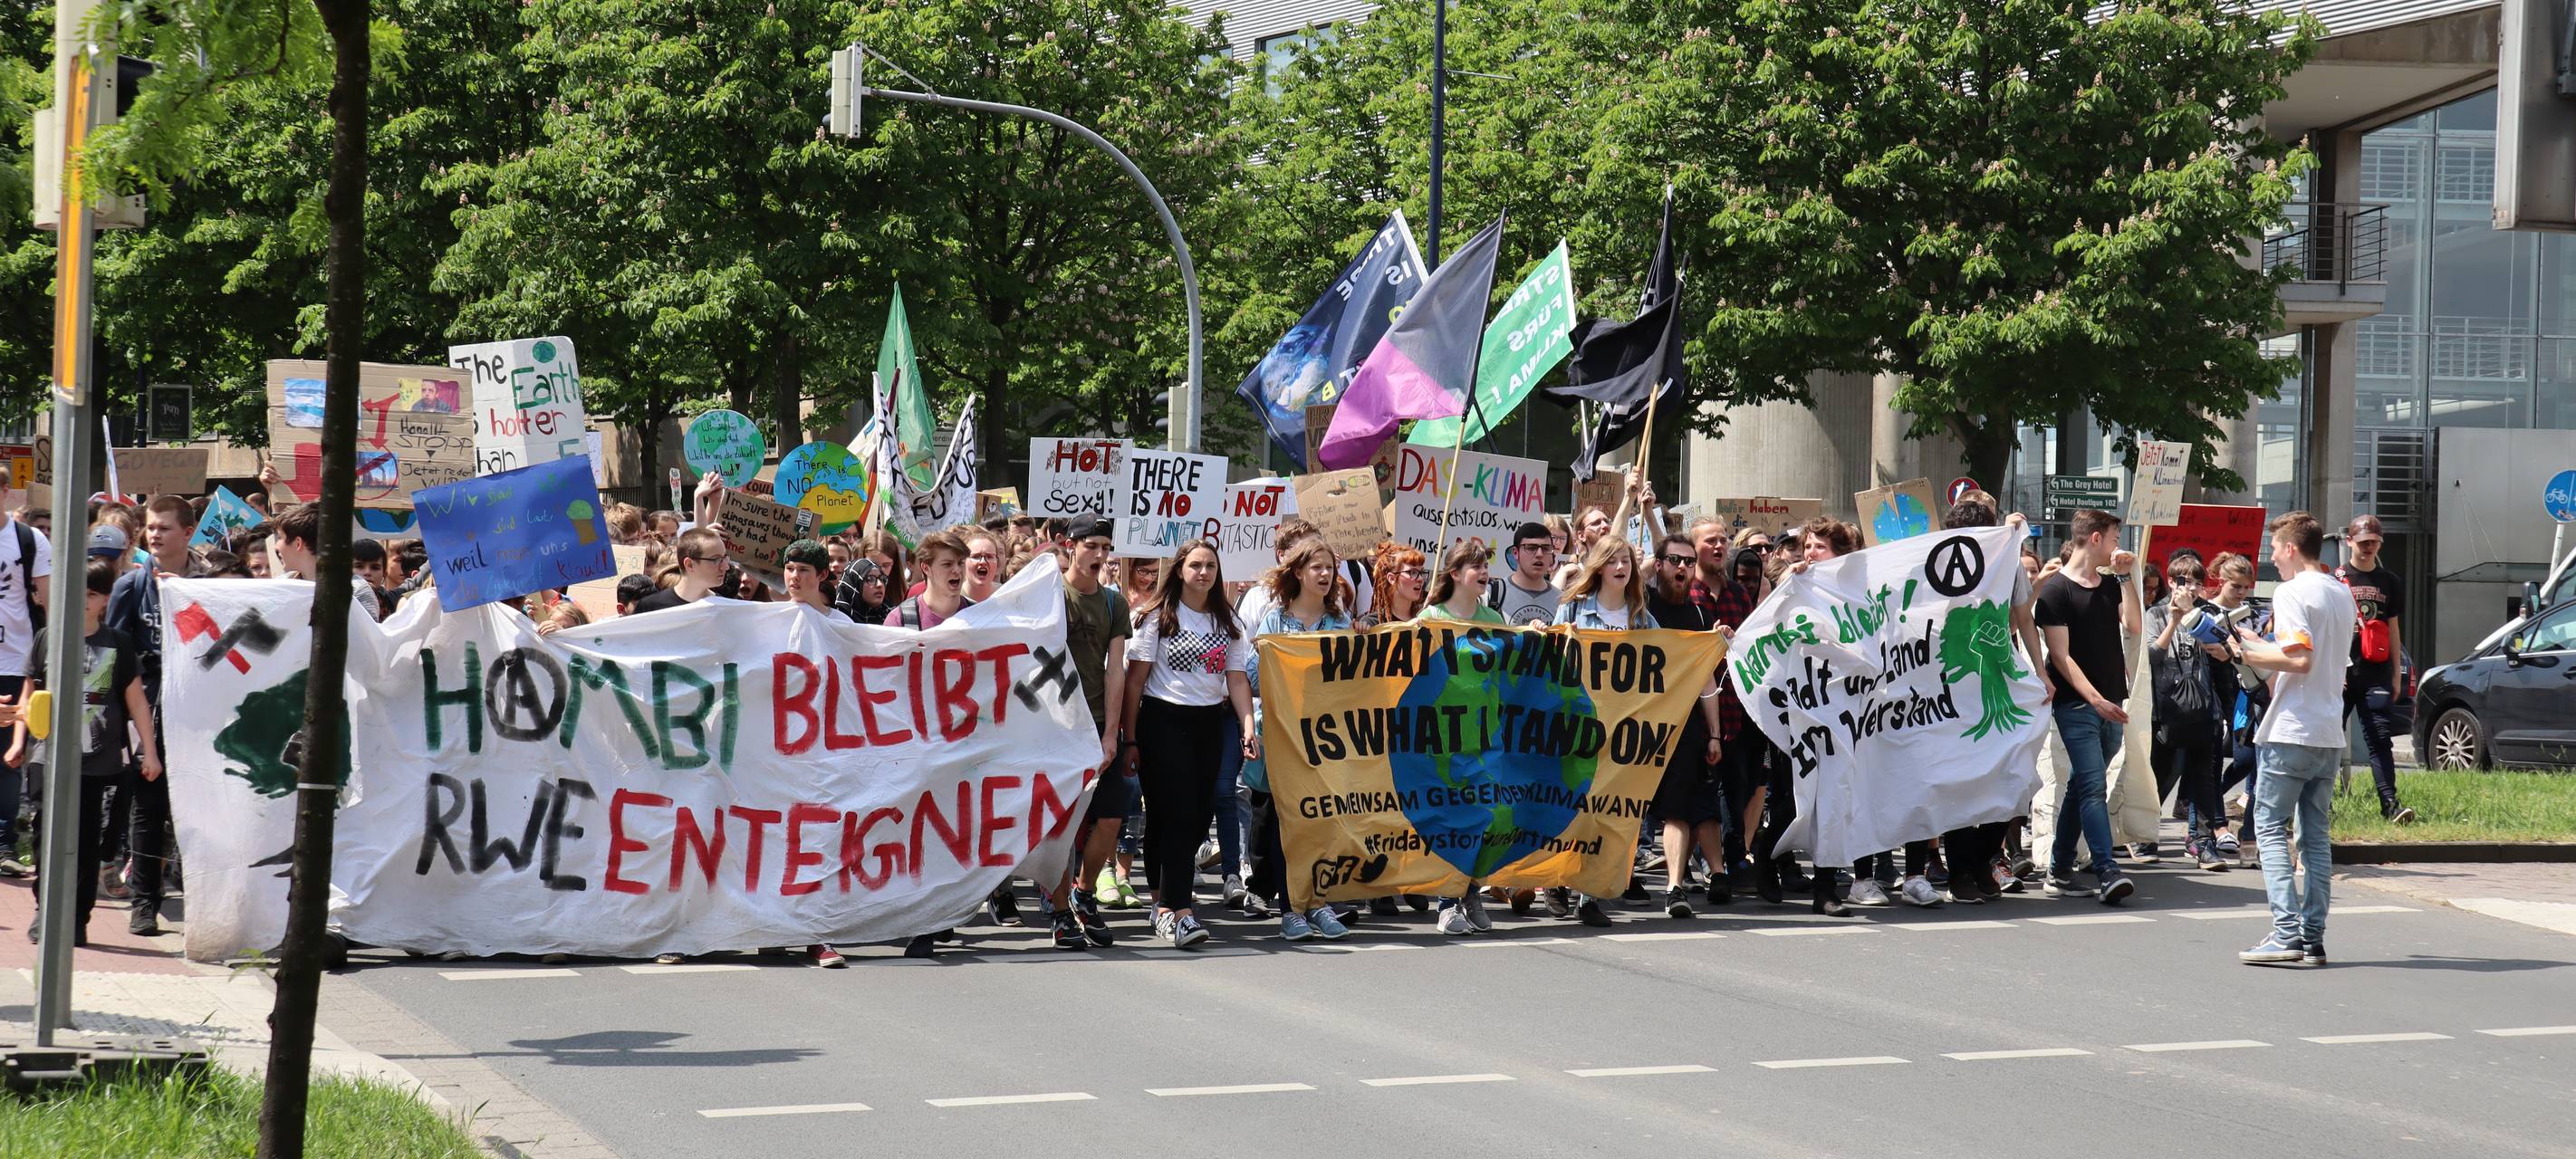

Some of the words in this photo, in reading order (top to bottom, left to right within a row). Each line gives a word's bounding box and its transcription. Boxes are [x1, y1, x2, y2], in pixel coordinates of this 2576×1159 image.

[454, 352, 507, 385] The
[509, 363, 582, 410] Earth
[490, 407, 568, 437] hotter
[395, 435, 475, 455] STOPP
[2140, 441, 2163, 466] Jetzt
[476, 446, 518, 476] han
[795, 459, 829, 471] There
[1132, 457, 1204, 493] THERE
[787, 477, 812, 494] NO
[1051, 473, 1081, 489] but
[1085, 474, 1113, 488] not
[2060, 479, 2073, 489] The
[2075, 480, 2092, 491] Grey
[2092, 480, 2112, 490] Hotel
[725, 492, 742, 509] I'm
[743, 502, 769, 517] sure
[774, 508, 792, 522] the
[816, 494, 854, 507] Planet
[1130, 490, 1151, 517] IS
[1157, 490, 1192, 518] NO
[1235, 485, 1286, 518] NOT
[1749, 499, 1789, 514] haben
[2059, 497, 2076, 505] Hotel
[2076, 498, 2103, 508] Boutique
[2104, 499, 2117, 507] 102
[722, 511, 771, 532] dinosaurs
[1128, 518, 1202, 548] PLANET
[1504, 519, 1523, 532] wi
[1732, 513, 1748, 527] die
[725, 539, 745, 554] ime
[745, 528, 768, 543] had
[447, 541, 490, 576] weil
[1320, 627, 1431, 683] WHAT
[1442, 628, 1458, 675] I
[1466, 627, 1583, 689] STAND
[1590, 641, 1667, 694] FOR
[419, 640, 739, 771] HAMBI
[771, 642, 1030, 756] BLEIBT
[1839, 674, 1960, 752] Verstand
[1300, 716, 1347, 767] IS
[1345, 704, 1468, 757] WHAT
[1480, 705, 1492, 752] I
[1497, 704, 1607, 760] TAND
[1610, 715, 1677, 768] ON!
[1300, 790, 1420, 820] GEMEINSAM
[1426, 781, 1500, 808] GEGEN
[415, 772, 600, 893] RWE
[602, 768, 1097, 896] ENTEIGNEN
